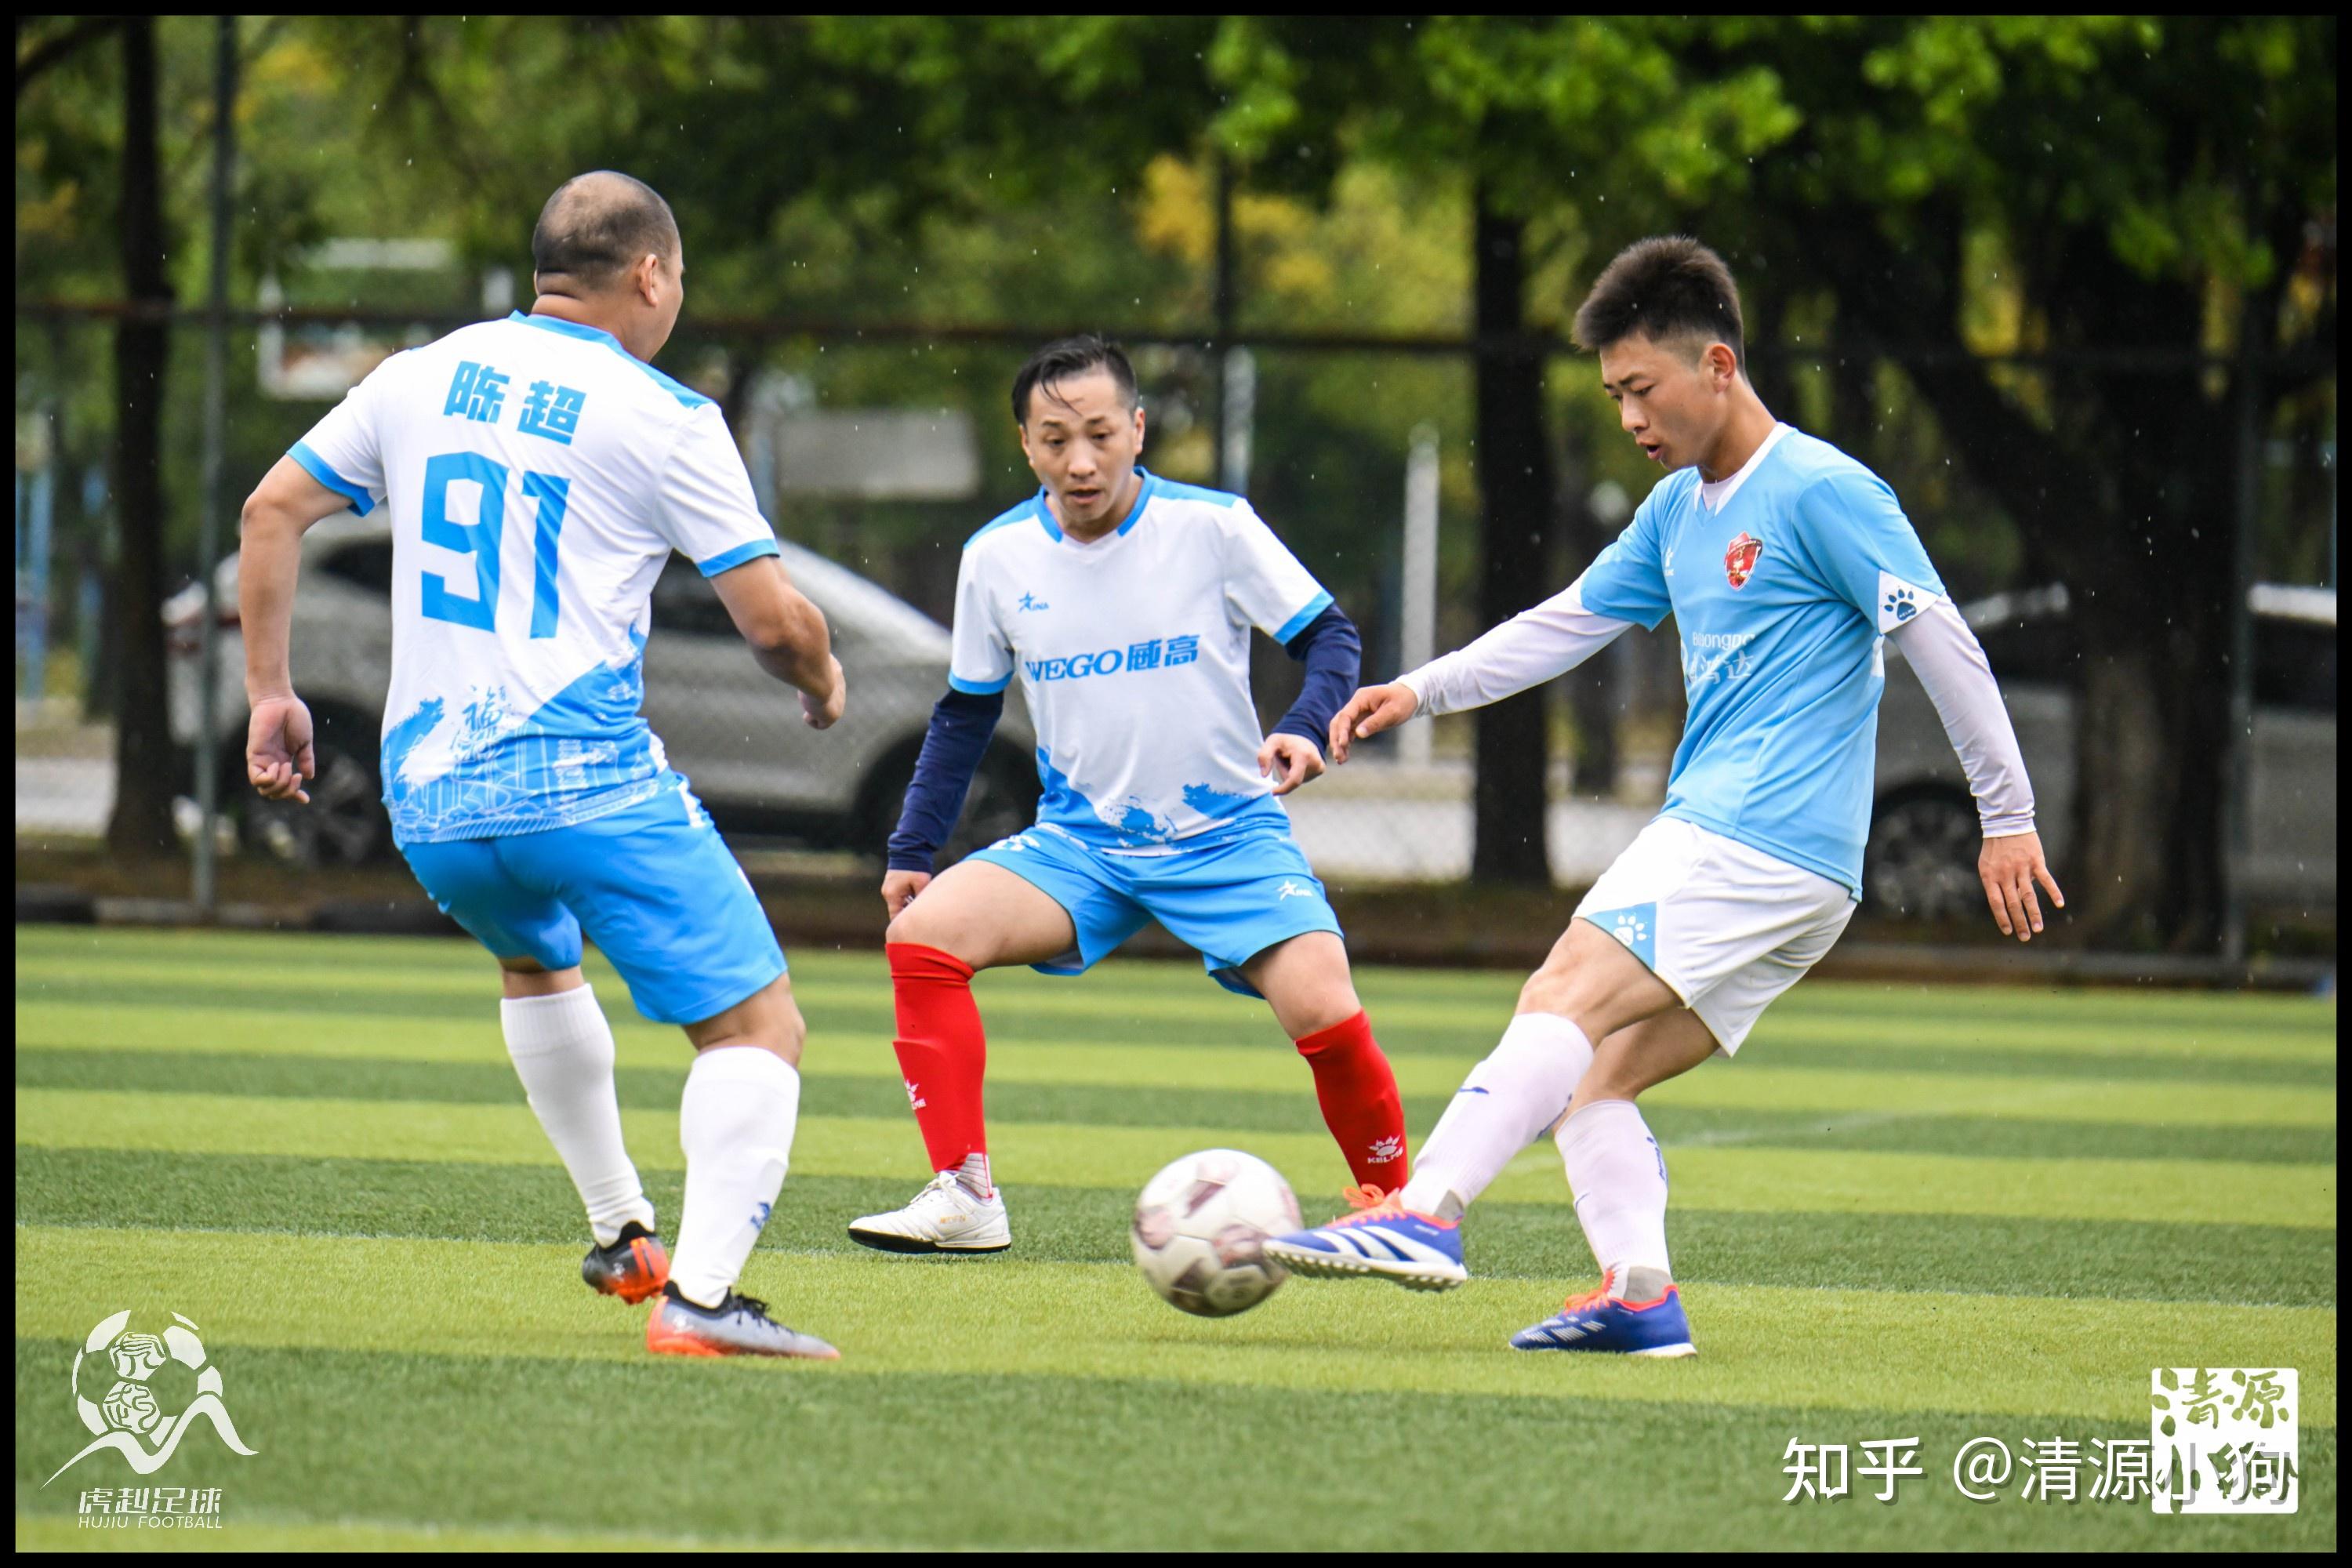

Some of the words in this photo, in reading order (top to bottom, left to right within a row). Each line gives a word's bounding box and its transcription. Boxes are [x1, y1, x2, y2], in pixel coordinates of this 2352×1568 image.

[443, 360, 586, 445] 陈超
[421, 451, 571, 639] 91
[1025, 649, 1123, 681] WEGO
[1126, 634, 1200, 672] 威高
